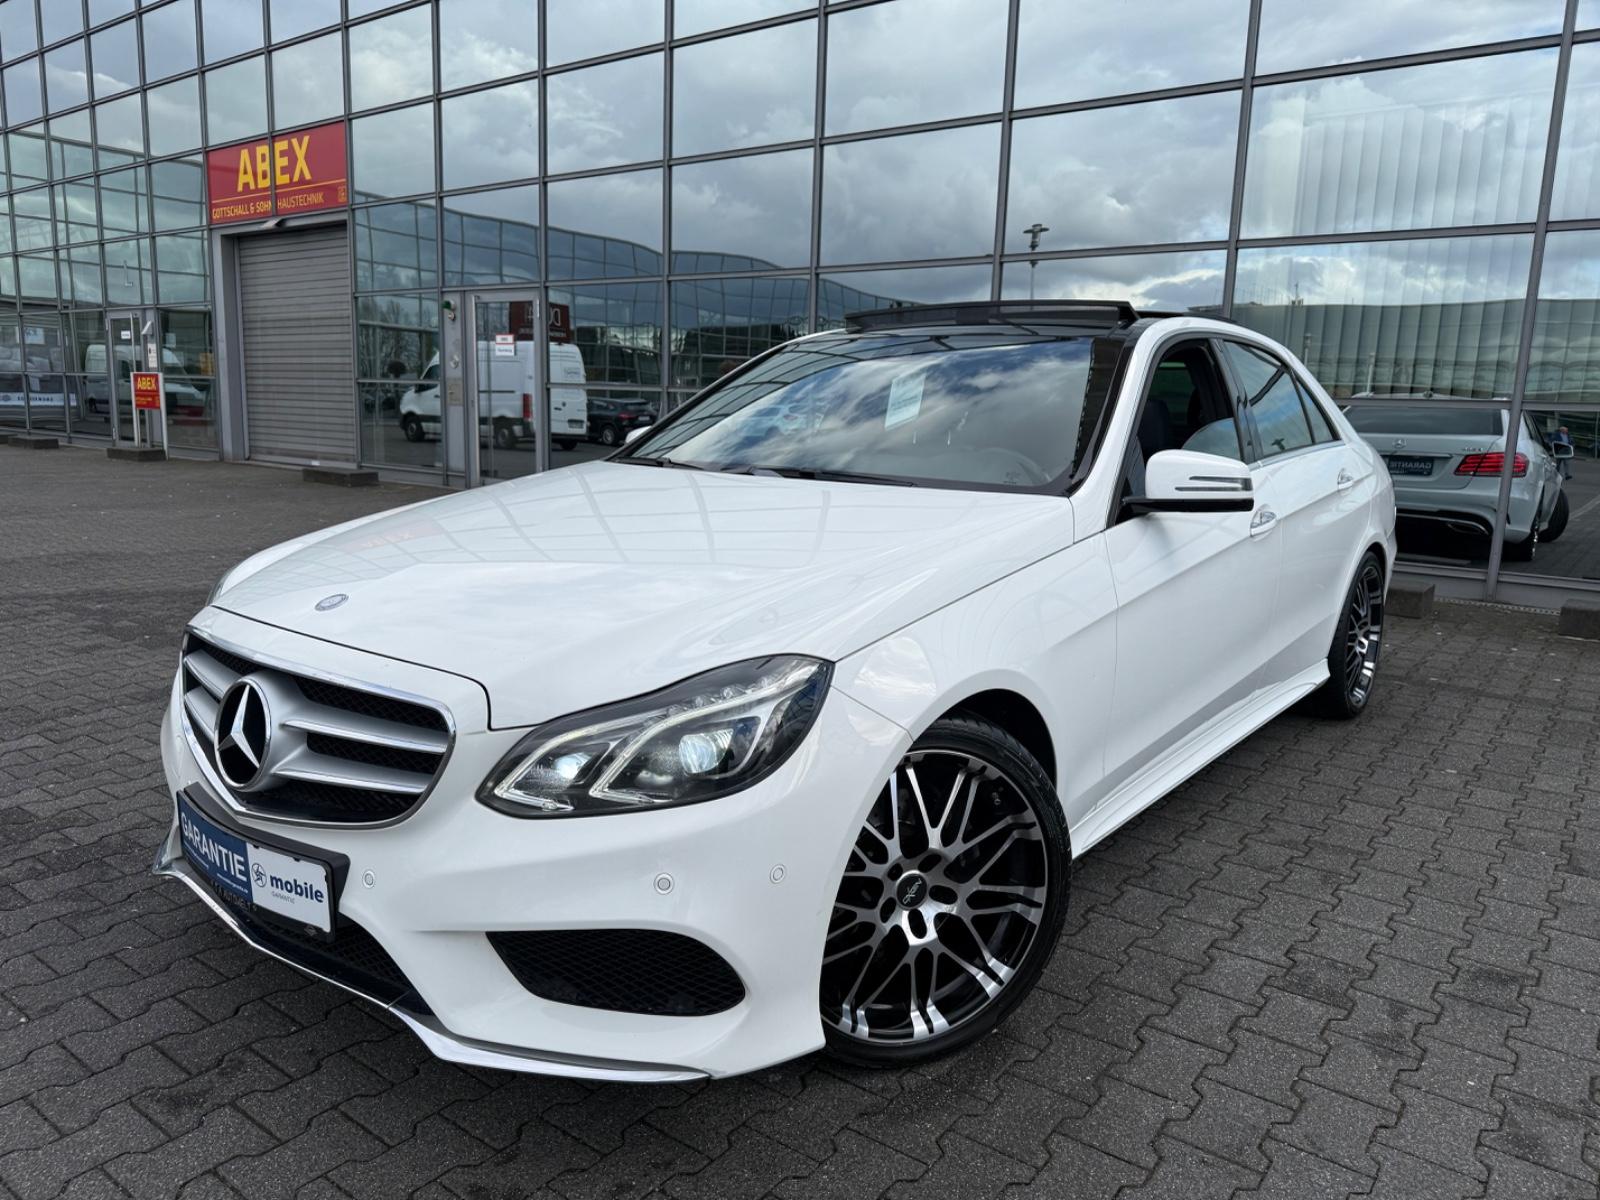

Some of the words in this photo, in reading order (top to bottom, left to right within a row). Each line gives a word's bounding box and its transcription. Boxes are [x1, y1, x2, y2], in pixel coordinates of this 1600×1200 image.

[238, 136, 311, 192] ABEX
[212, 202, 249, 219] GOTTSCHALL
[250, 203, 255, 213] &
[256, 201, 272, 213] SOHN
[277, 192, 324, 209] HAUSTECHNIK
[137, 377, 156, 390] ABEX
[181, 812, 247, 881] GARANTIE
[270, 874, 324, 903] mobile
